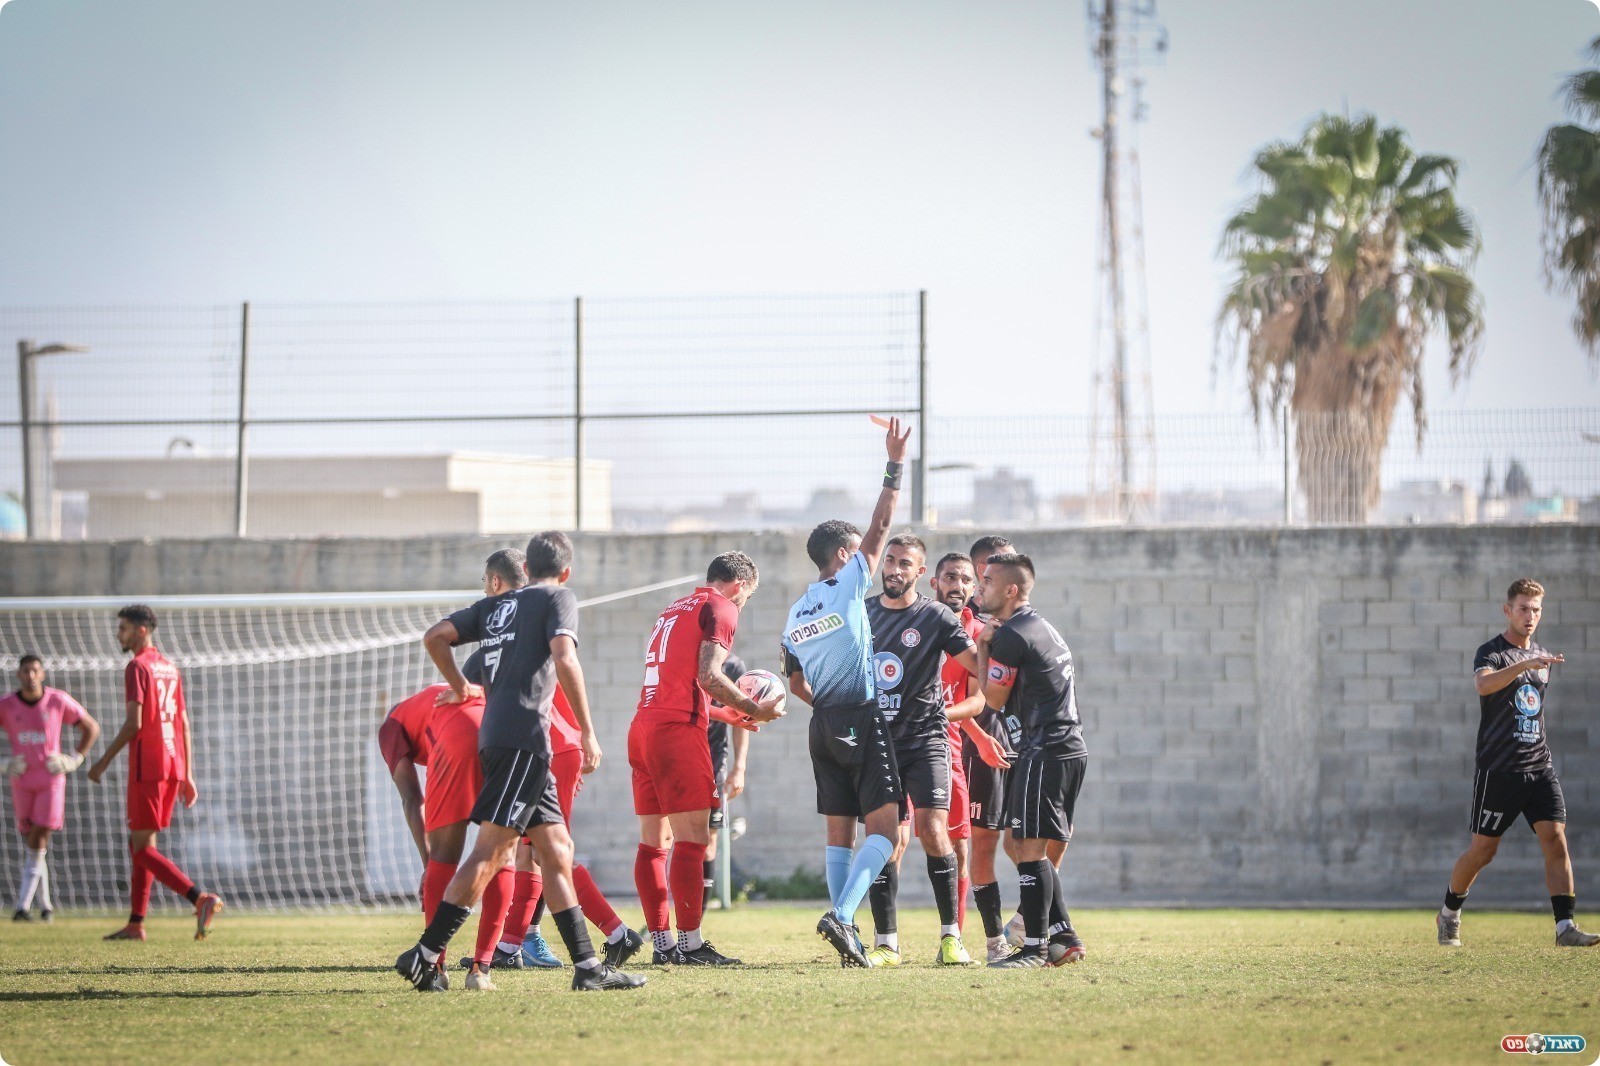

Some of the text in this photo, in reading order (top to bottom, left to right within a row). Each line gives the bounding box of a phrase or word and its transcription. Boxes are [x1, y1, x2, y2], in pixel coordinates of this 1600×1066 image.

[817, 614, 843, 633] מגה
[645, 615, 679, 664] 21
[485, 648, 503, 683] 7
[157, 679, 178, 722] 24
[1515, 715, 1540, 733] Ten
[511, 801, 527, 821] 7
[970, 802, 982, 819] 11
[1481, 809, 1504, 831] 77
